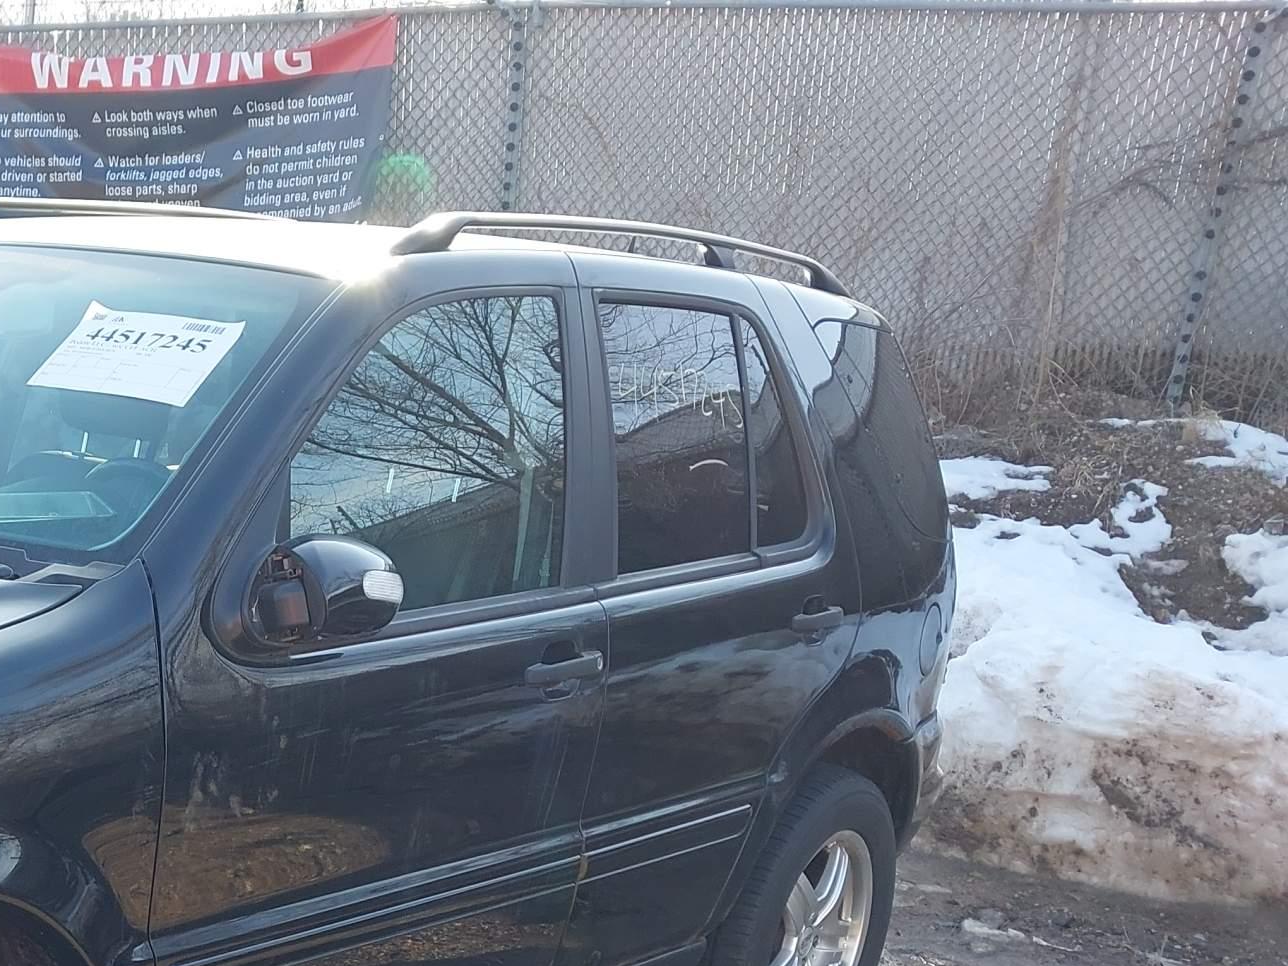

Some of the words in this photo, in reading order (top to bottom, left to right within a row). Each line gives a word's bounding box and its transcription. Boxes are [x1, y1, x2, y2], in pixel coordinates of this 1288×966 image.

[30, 49, 314, 89] WARNING
[246, 98, 285, 114] Closed
[288, 97, 304, 109] toe
[307, 91, 354, 108] footwear
[11, 110, 54, 123] attention
[56, 111, 66, 123] to
[104, 110, 128, 123] Look
[130, 108, 154, 122] both
[156, 109, 184, 122] ways
[187, 106, 218, 119] when
[248, 115, 274, 128] must
[277, 112, 290, 126] be
[293, 112, 320, 124] worn
[322, 109, 332, 120] in
[334, 104, 360, 118] yard.
[14, 126, 82, 141] surroundings.
[106, 124, 150, 139] crossing
[152, 122, 186, 136] aisles.
[246, 144, 282, 160] Health
[284, 142, 304, 156] and
[306, 140, 336, 154] safety
[338, 136, 366, 150] rules
[4, 155, 46, 167] vehicles
[48, 154, 82, 167] should
[108, 154, 142, 168] Watch
[144, 154, 160, 166] for
[162, 150, 206, 166] loaders/
[246, 162, 260, 176] do
[262, 160, 278, 174] not
[281, 158, 314, 174] permit
[316, 154, 358, 168] children
[1, 170, 34, 182] driven
[36, 172, 46, 183] or
[49, 170, 82, 182] started
[106, 169, 147, 181] forklifts,
[149, 167, 186, 182] jagged
[188, 166, 224, 180] edges,
[245, 178, 255, 191] in
[257, 176, 274, 190] the
[276, 174, 314, 188] auction
[316, 172, 340, 187] yard
[342, 170, 353, 181] or
[105, 184, 132, 196] loose
[136, 182, 165, 198] parts,
[168, 182, 198, 196] sharp
[244, 192, 281, 207] bidding
[284, 192, 310, 204] area,
[312, 188, 338, 200] even
[340, 184, 348, 196] if
[314, 204, 326, 218] by
[328, 203, 341, 214] an
[86, 328, 213, 354] 44517245
